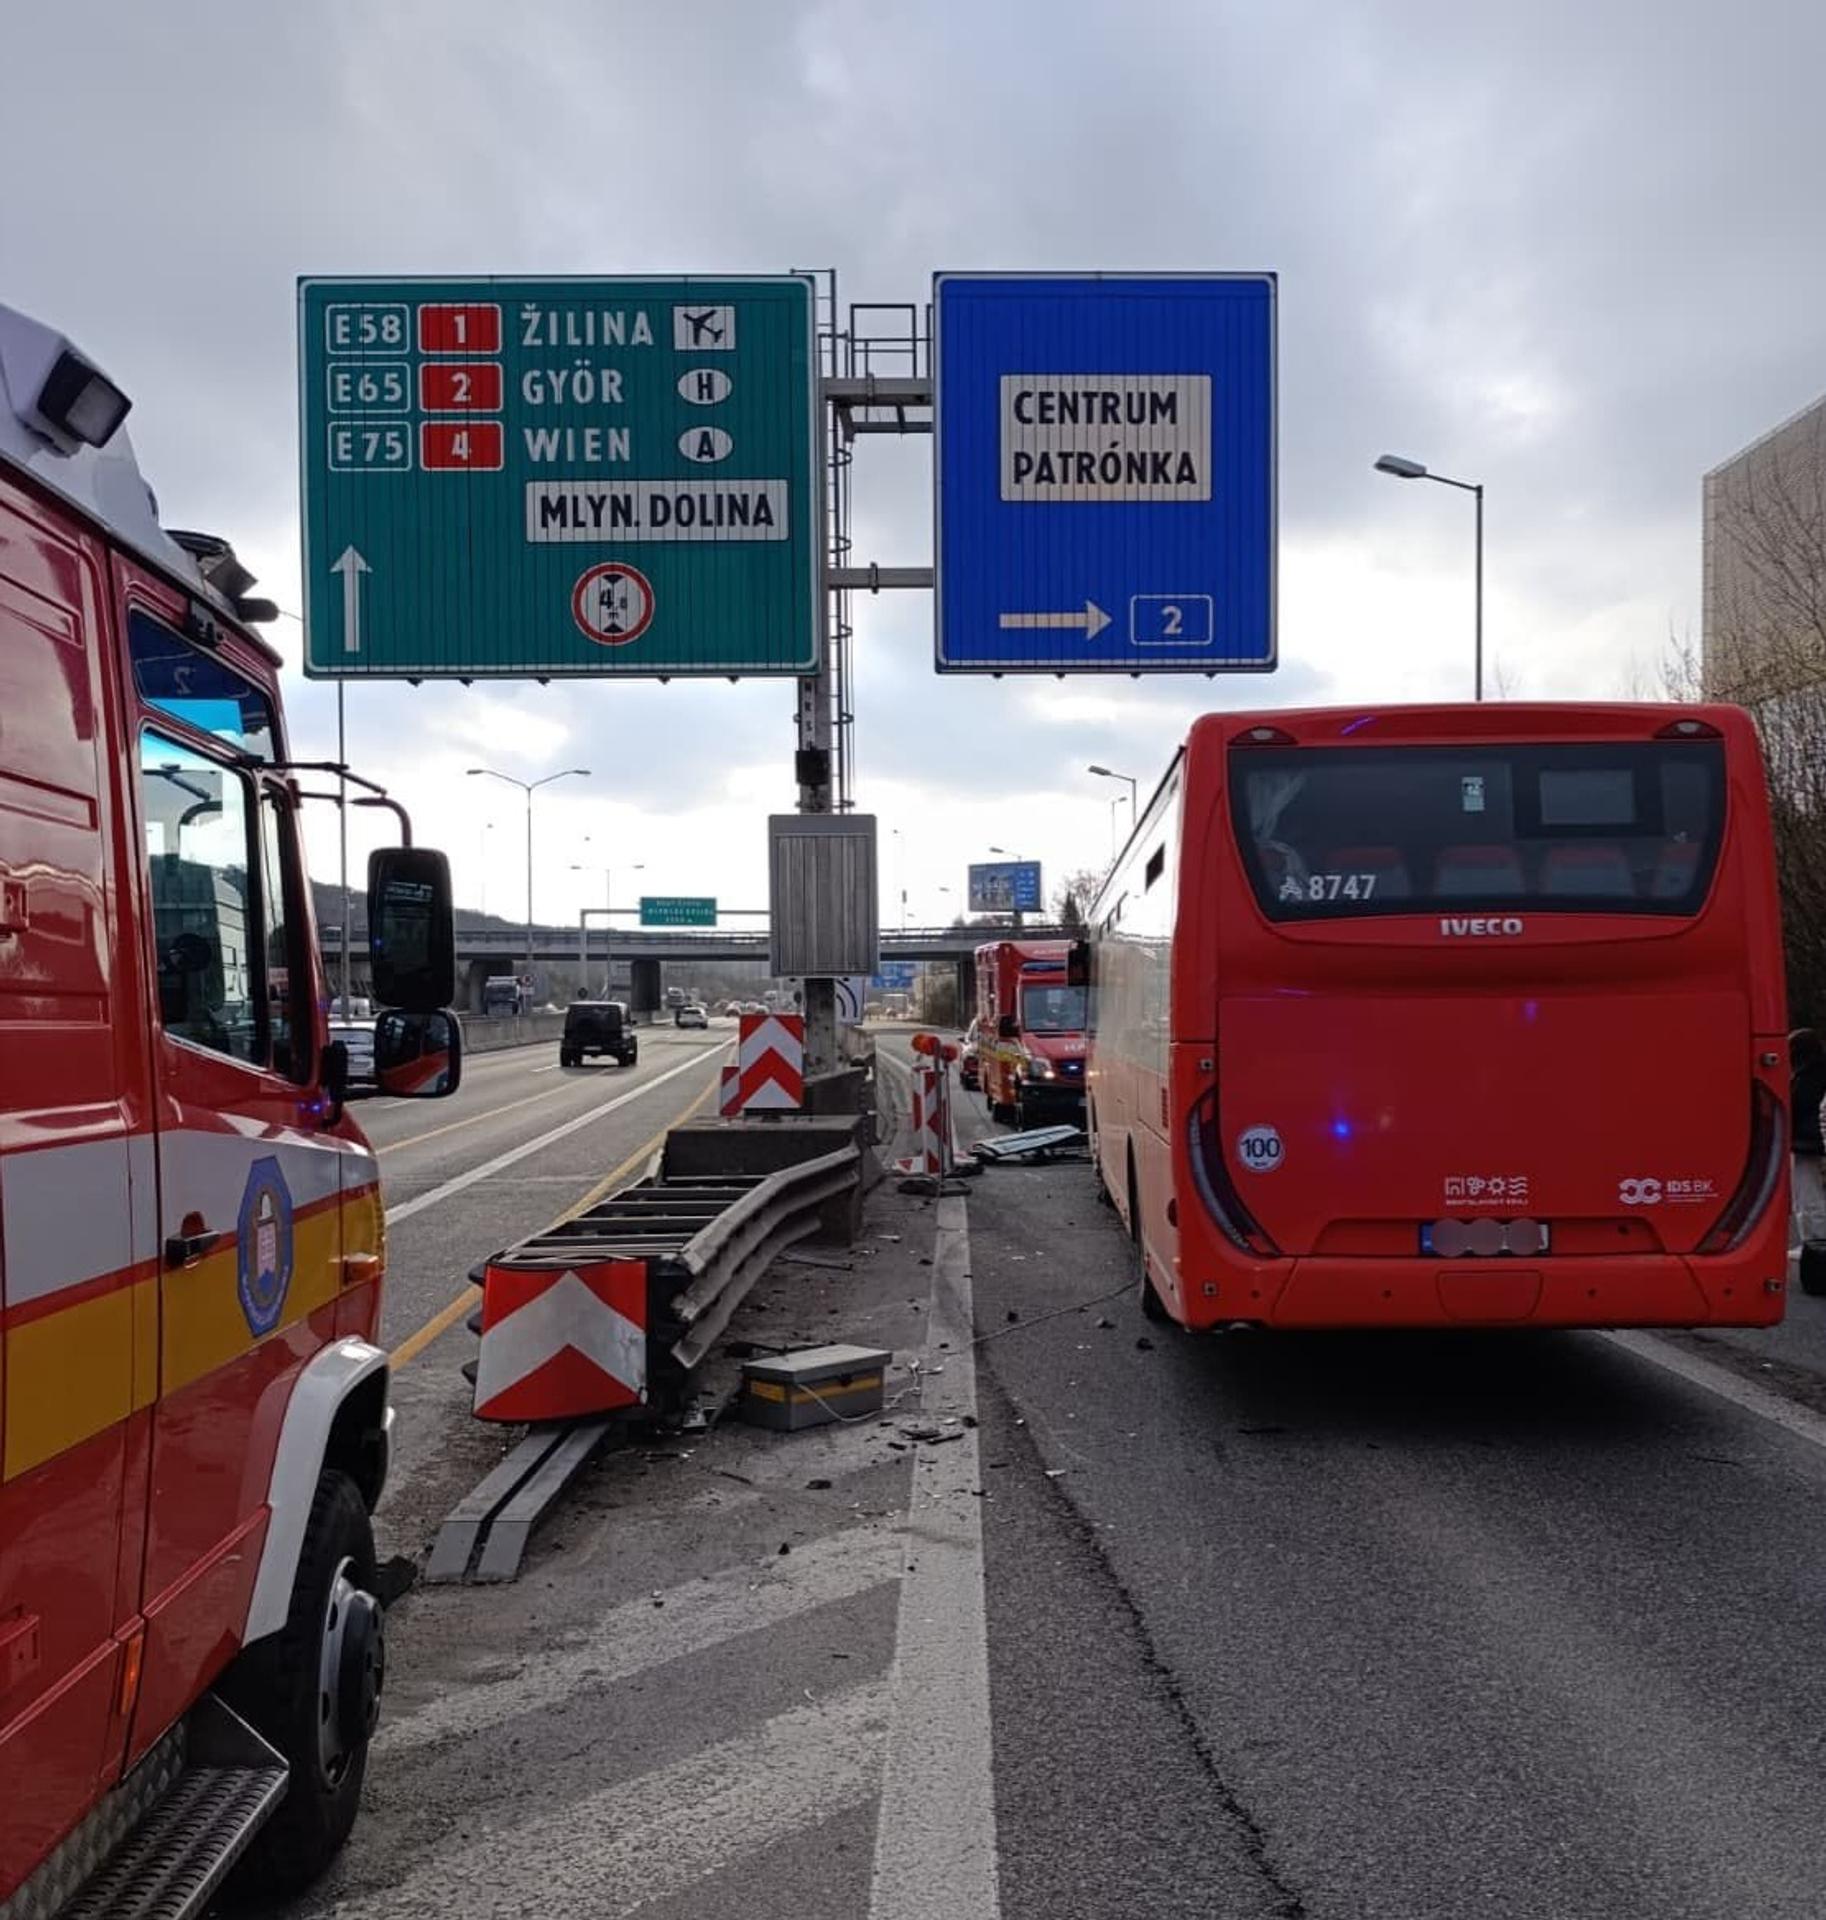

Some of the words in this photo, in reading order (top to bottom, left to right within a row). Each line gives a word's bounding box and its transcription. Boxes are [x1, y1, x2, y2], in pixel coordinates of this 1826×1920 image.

[336, 314, 401, 344] E58
[454, 314, 466, 344] 1
[520, 303, 654, 346] ŽILINA
[336, 372, 402, 403] E65
[451, 372, 472, 402] 2
[522, 359, 623, 405] GYÖR
[697, 372, 714, 401] H
[1014, 390, 1177, 425] CENTRUM
[337, 431, 403, 462] E75
[451, 430, 472, 461] 4
[523, 427, 630, 462] WIEN
[696, 430, 716, 460] A
[1013, 441, 1197, 485] PATRÓNKA
[540, 494, 641, 529] MLYN.
[649, 493, 774, 528] DOLINA
[1161, 605, 1183, 635] 2
[1308, 874, 1377, 900] 8747
[1440, 918, 1523, 936] IVECO
[1240, 1137, 1280, 1158] 100
